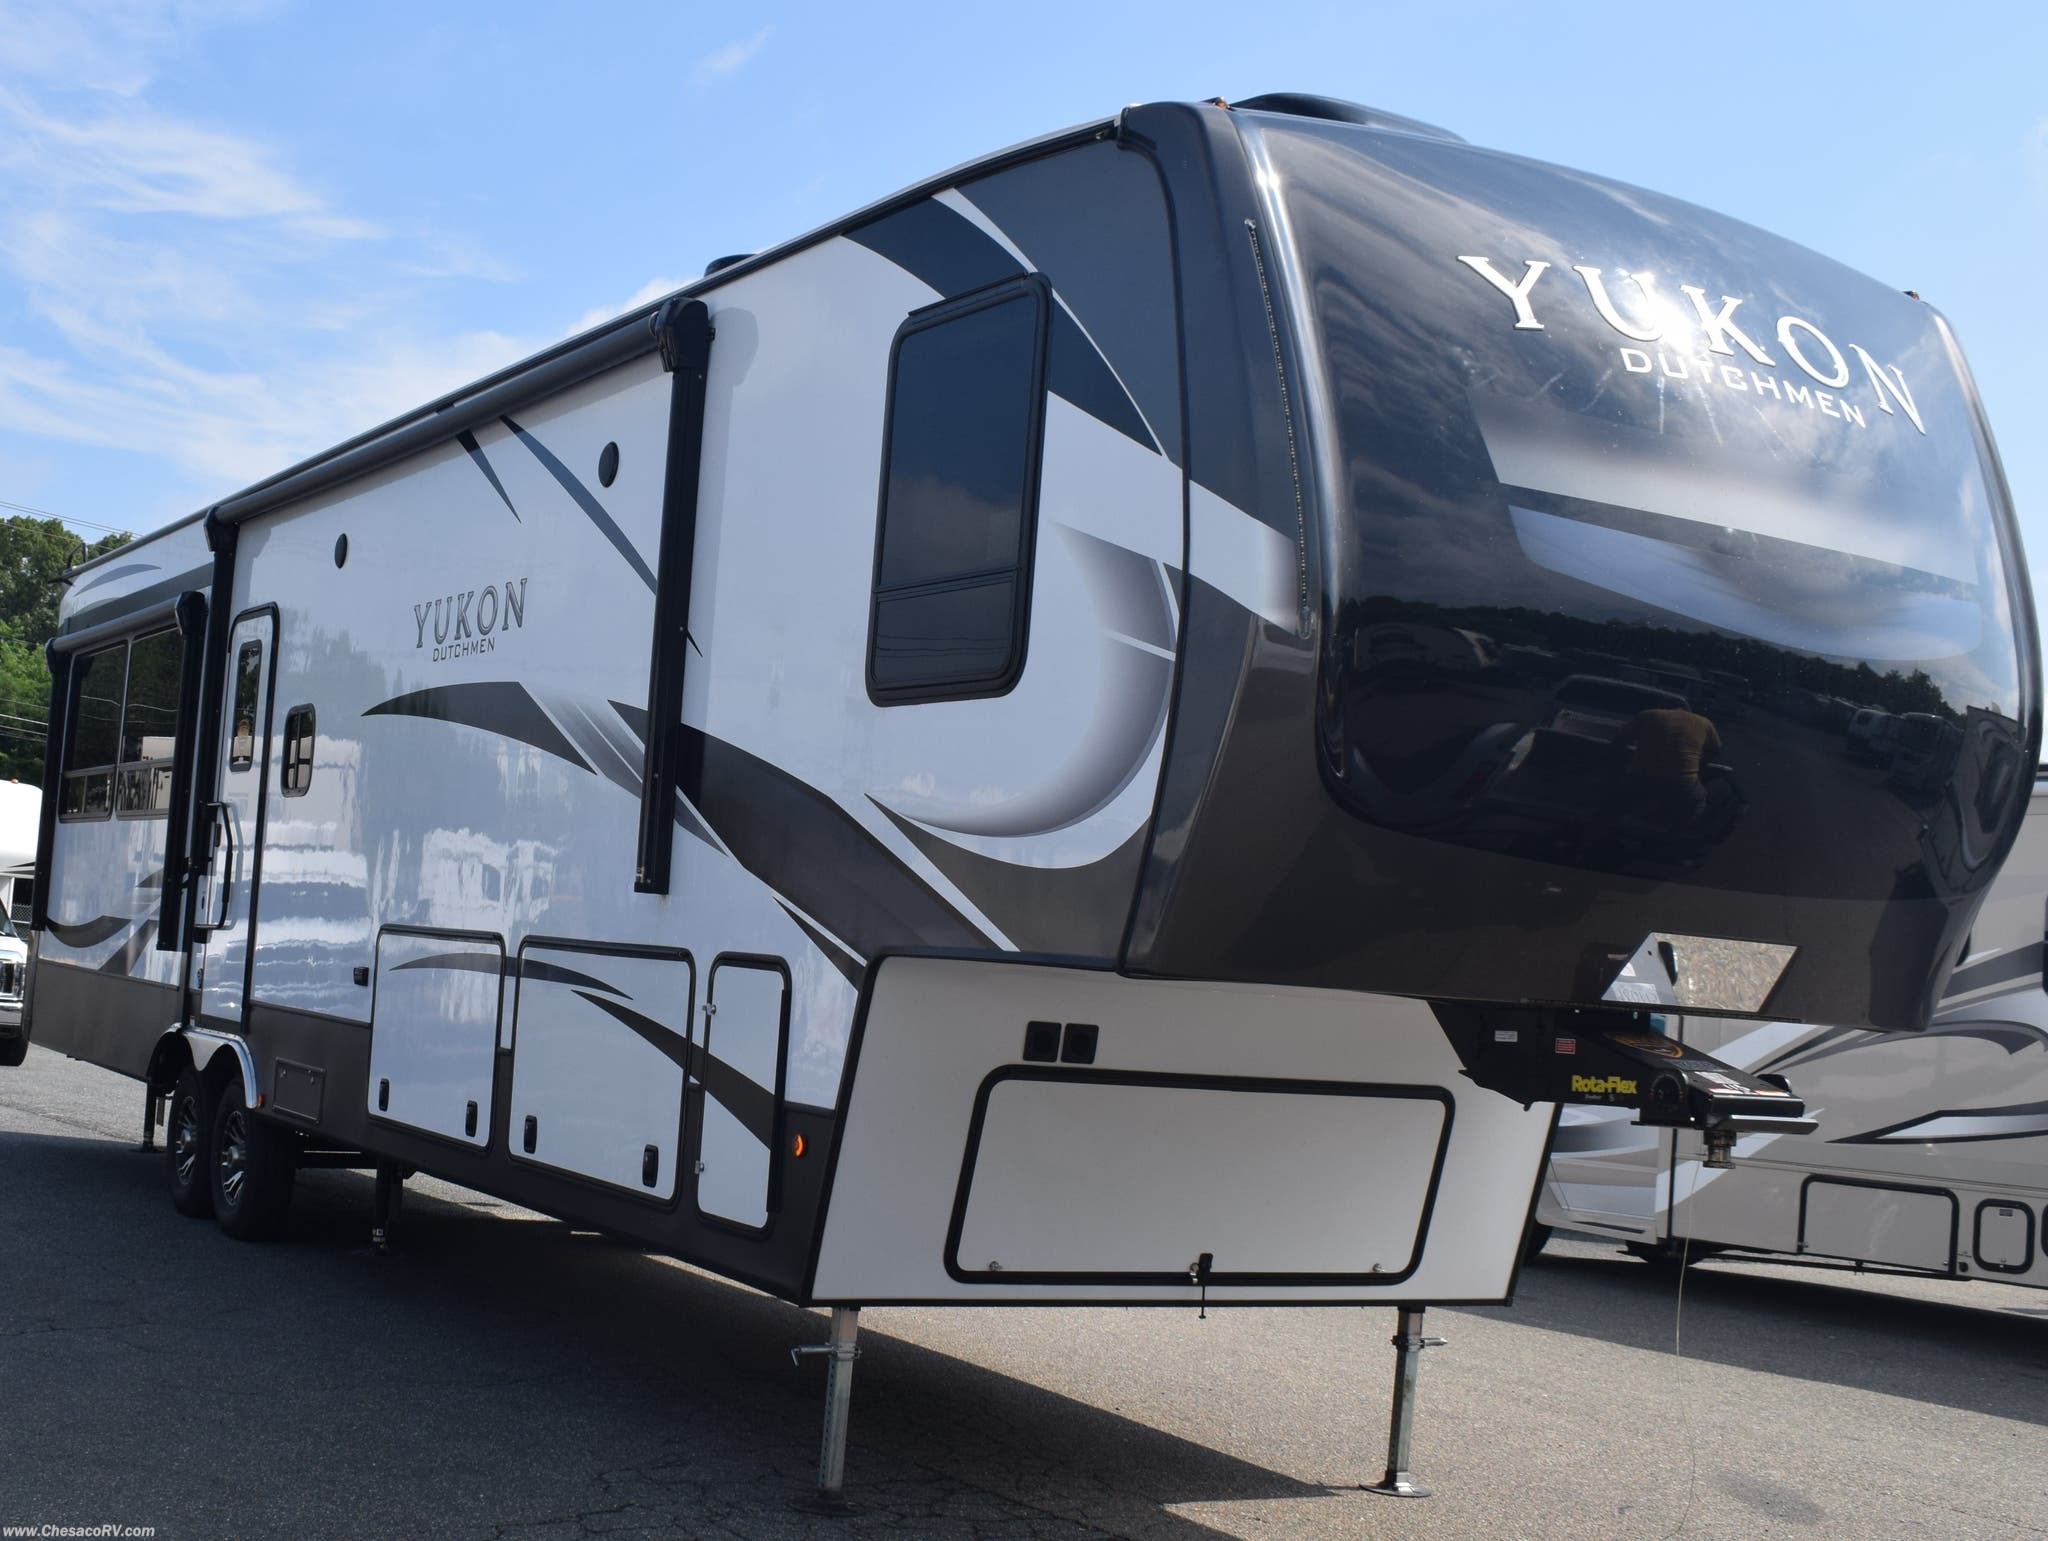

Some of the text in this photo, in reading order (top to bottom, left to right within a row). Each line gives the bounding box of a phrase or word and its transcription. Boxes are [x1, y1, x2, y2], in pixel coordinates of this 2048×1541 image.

[1457, 255, 1926, 435] YUKON
[1619, 348, 1867, 429] DUTCHMEN
[414, 578, 528, 648] YUKON
[433, 638, 496, 662] DUTCHMEN
